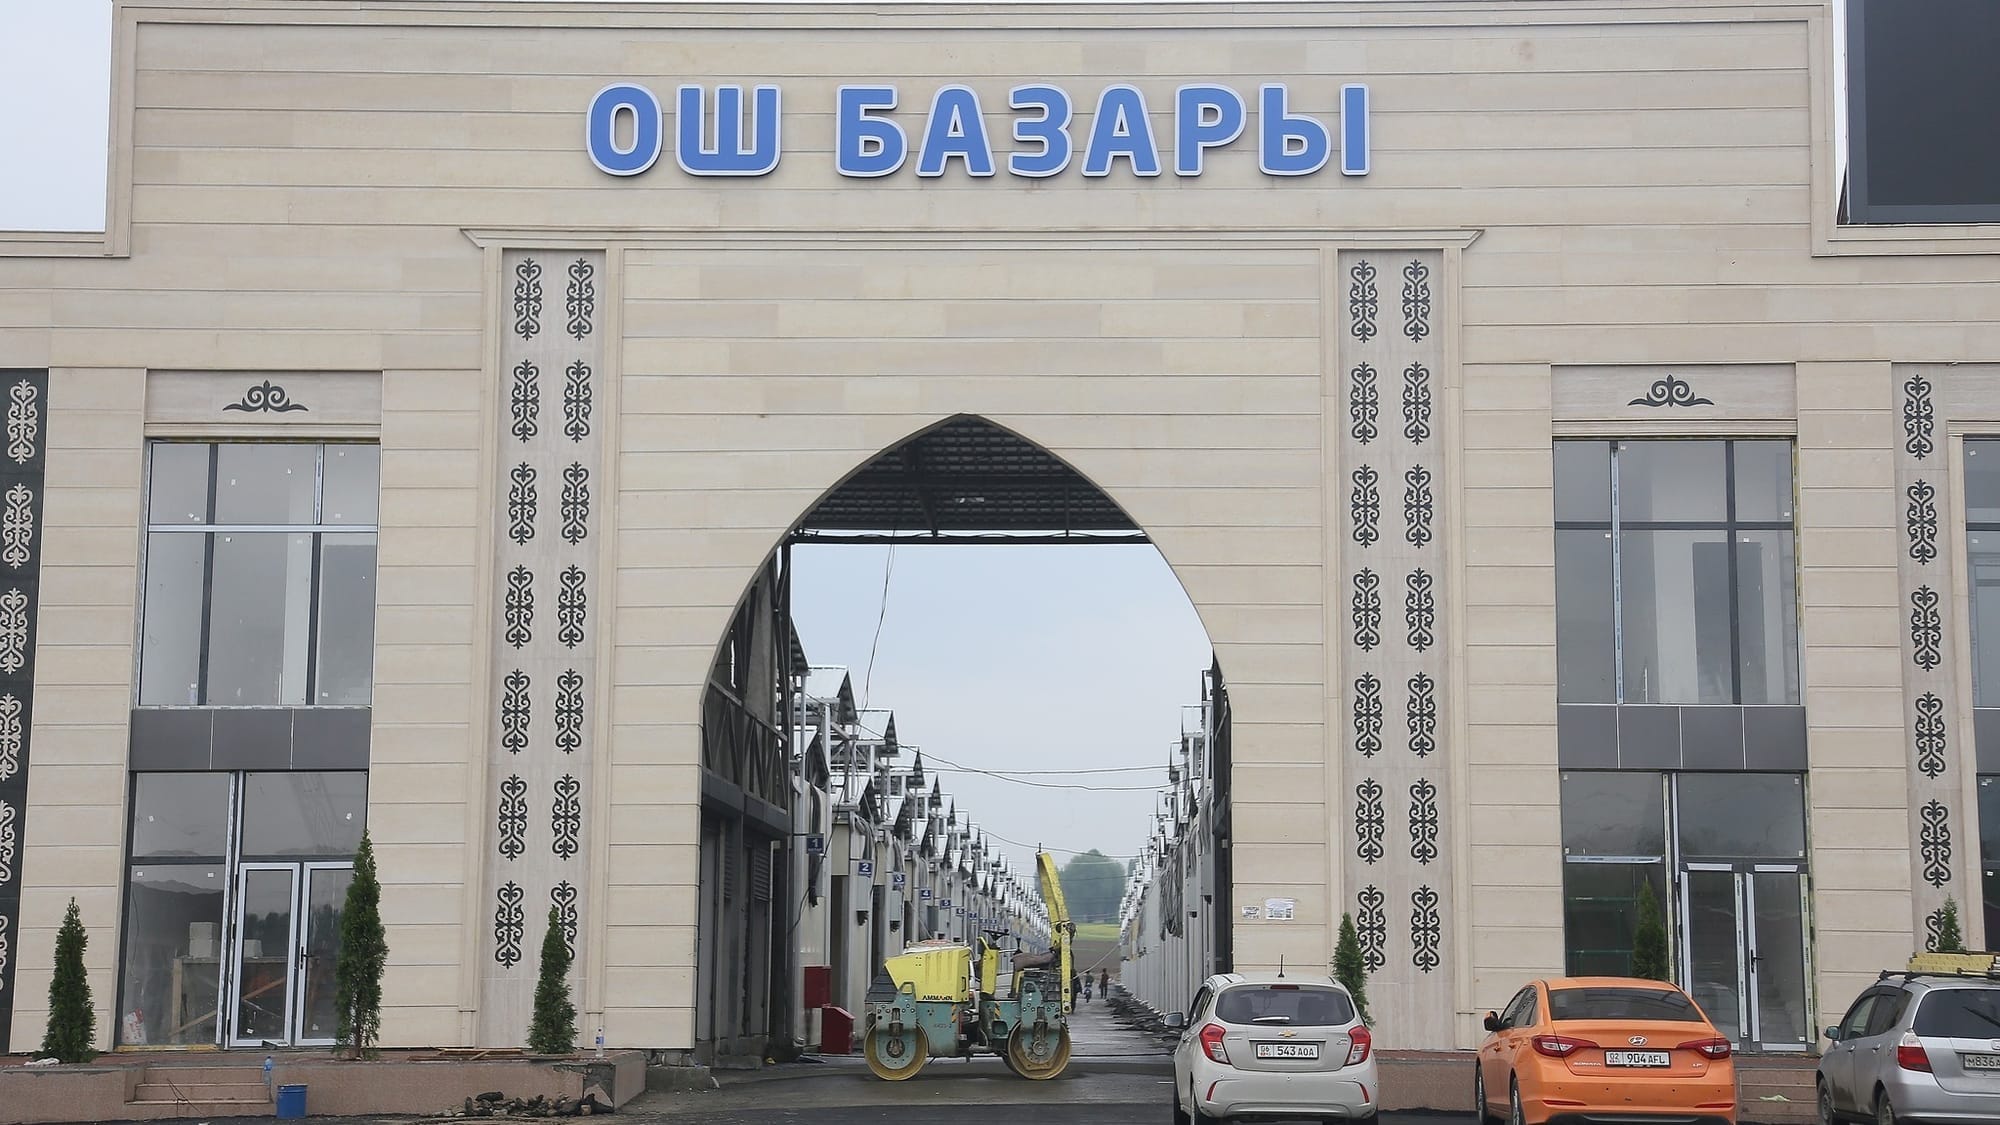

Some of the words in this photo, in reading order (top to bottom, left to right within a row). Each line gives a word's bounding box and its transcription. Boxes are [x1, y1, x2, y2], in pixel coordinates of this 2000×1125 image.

[587, 83, 781, 176] ОШ
[836, 83, 1369, 177] БАЗАРЫ
[812, 838, 819, 848] 1
[862, 863, 869, 871] 2
